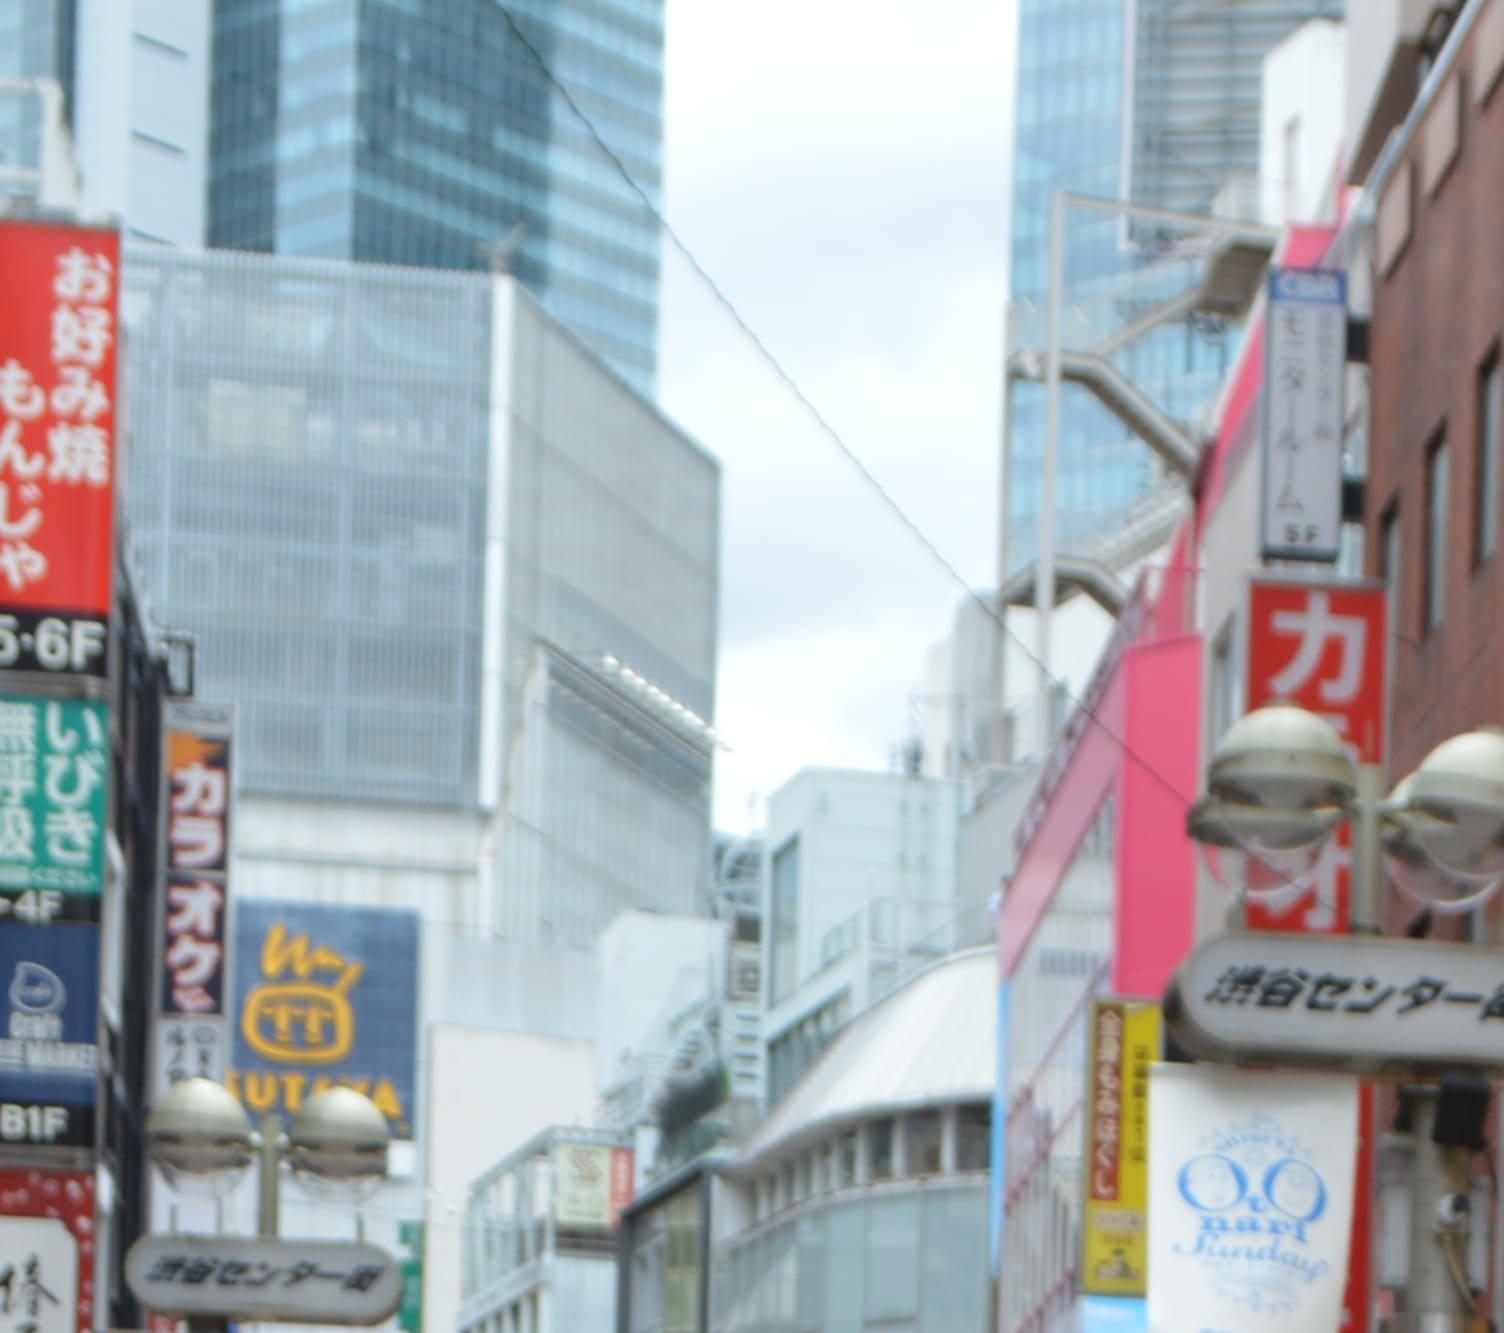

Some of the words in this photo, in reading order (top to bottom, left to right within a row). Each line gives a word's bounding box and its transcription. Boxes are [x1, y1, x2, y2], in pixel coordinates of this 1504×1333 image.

[48, 246, 113, 487] お好み焼
[45, 701, 106, 866] いびき
[14, 888, 64, 923] 4F
[166, 763, 226, 988] カラオケ
[145, 1256, 385, 1292] 渋谷センター街
